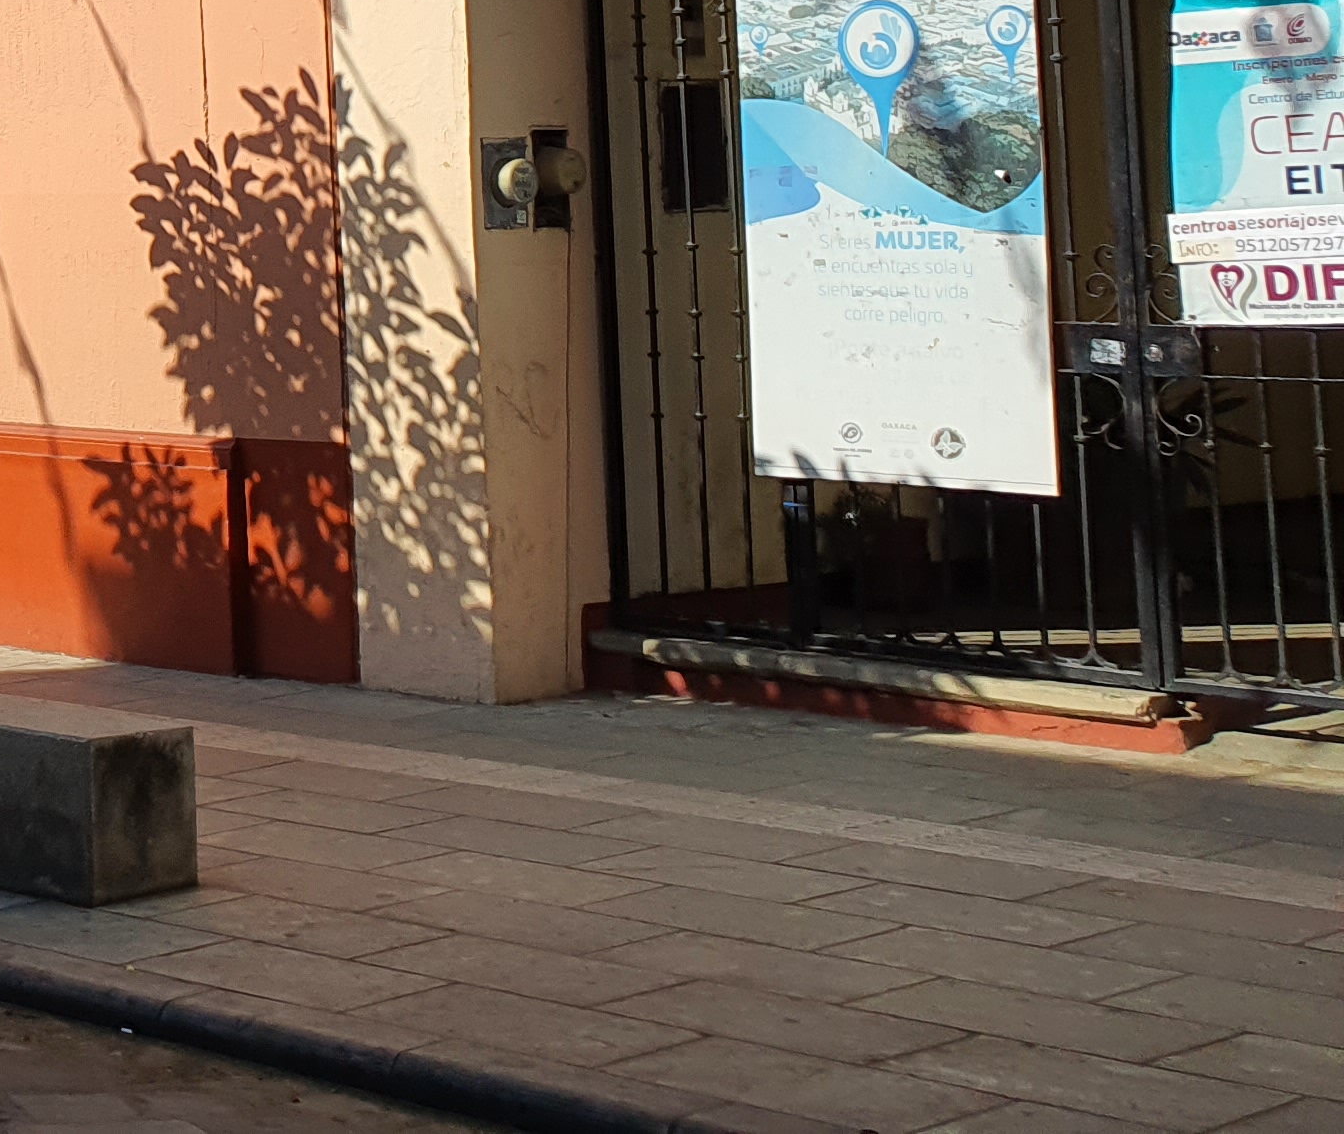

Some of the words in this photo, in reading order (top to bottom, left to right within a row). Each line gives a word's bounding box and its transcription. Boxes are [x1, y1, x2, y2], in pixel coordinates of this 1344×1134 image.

[1232, 56, 1328, 72] Inscripciones
[1248, 92, 1292, 105] Centro
[1296, 91, 1312, 102] de
[838, 237, 872, 250] eres
[874, 230, 966, 254] MUJER,
[1235, 236, 1344, 253] 9512057297
[831, 260, 921, 275] encuentras
[925, 259, 958, 275] sola
[963, 263, 974, 278] y
[1263, 263, 1344, 301] DIF
[818, 283, 874, 298] sientes
[879, 286, 910, 301] que
[914, 284, 930, 299] tu
[934, 284, 969, 299] vida
[844, 309, 885, 322] corre
[881, 422, 918, 431] OAXACA
